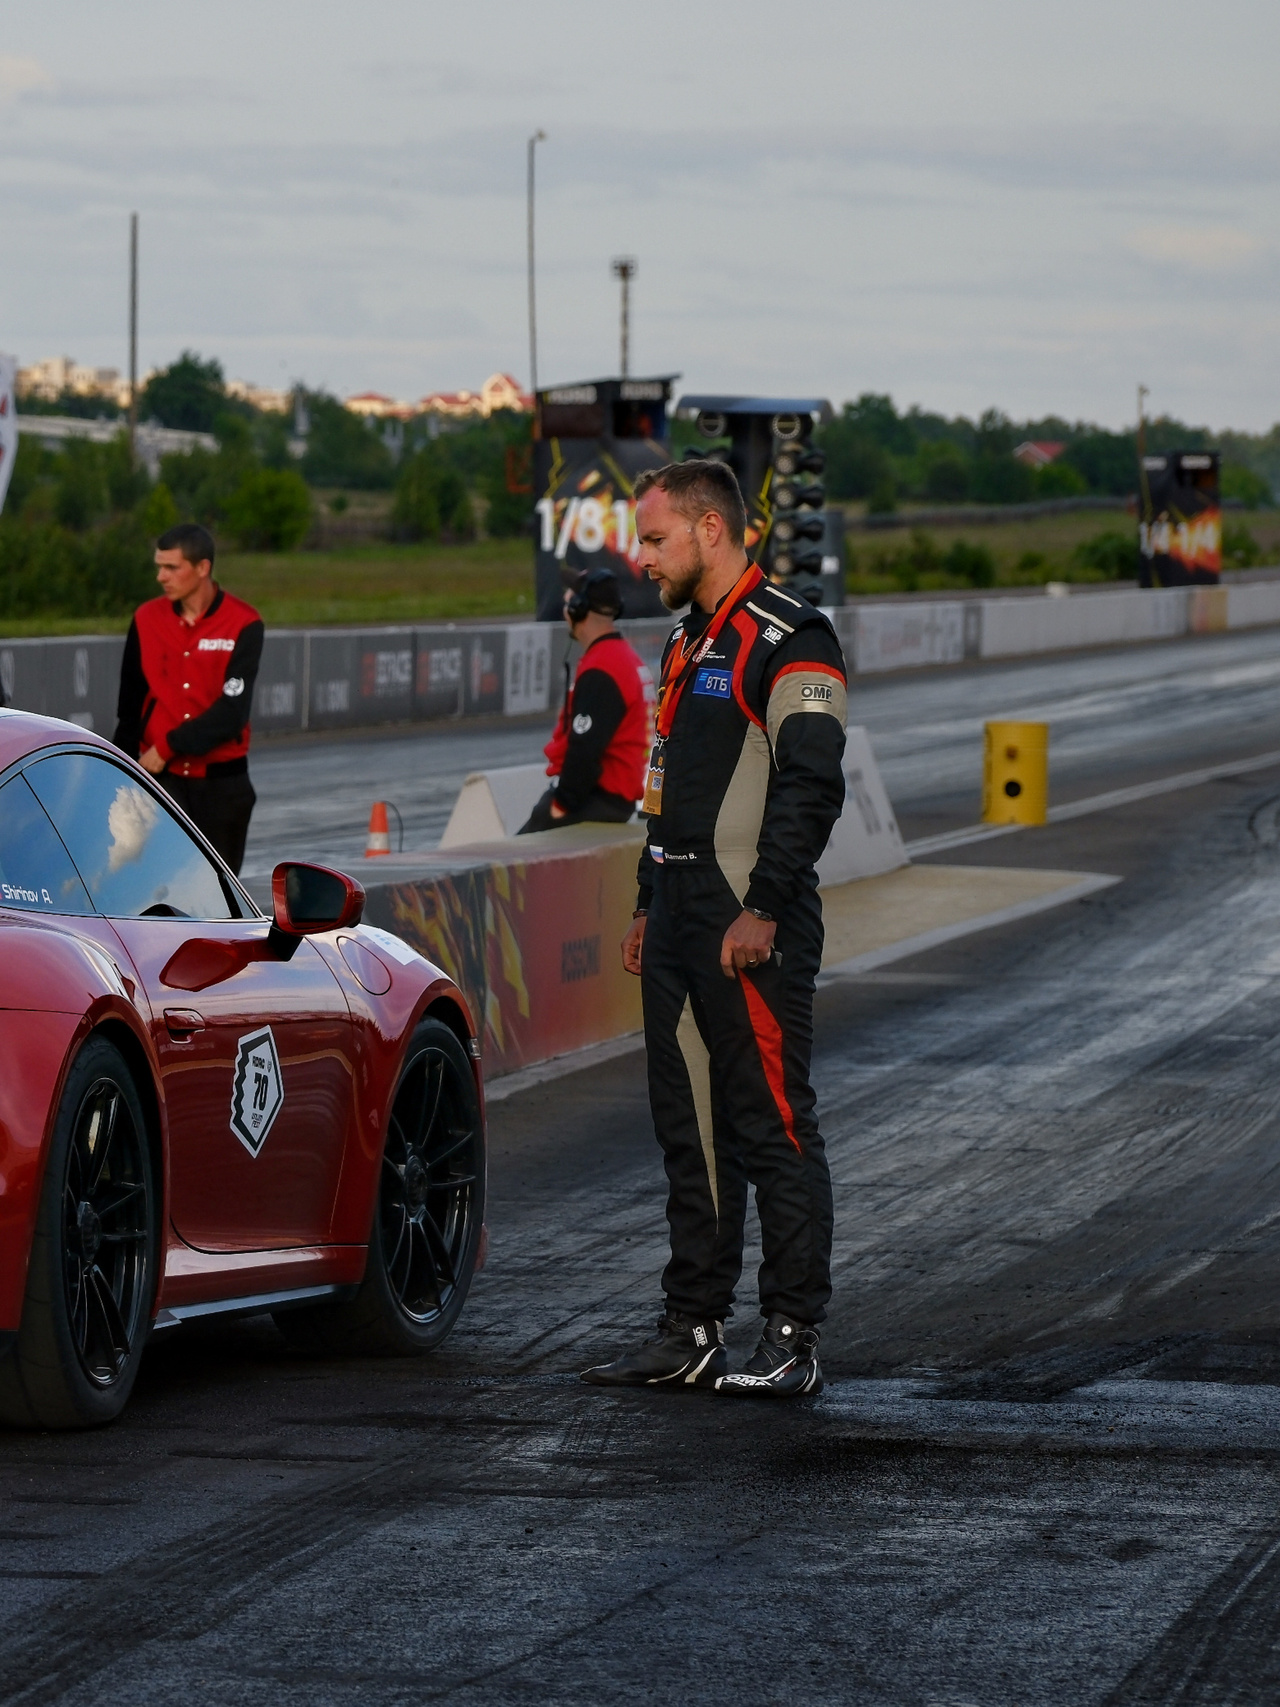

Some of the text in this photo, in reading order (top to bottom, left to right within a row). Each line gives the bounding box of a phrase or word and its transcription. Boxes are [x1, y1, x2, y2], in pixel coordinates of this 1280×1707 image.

[535, 496, 605, 560] 1/8
[764, 626, 782, 642] OMP
[801, 686, 833, 700] OMP
[1, 883, 38, 902] Shirinov
[253, 1072, 268, 1111] 70
[695, 1326, 707, 1347] OMP
